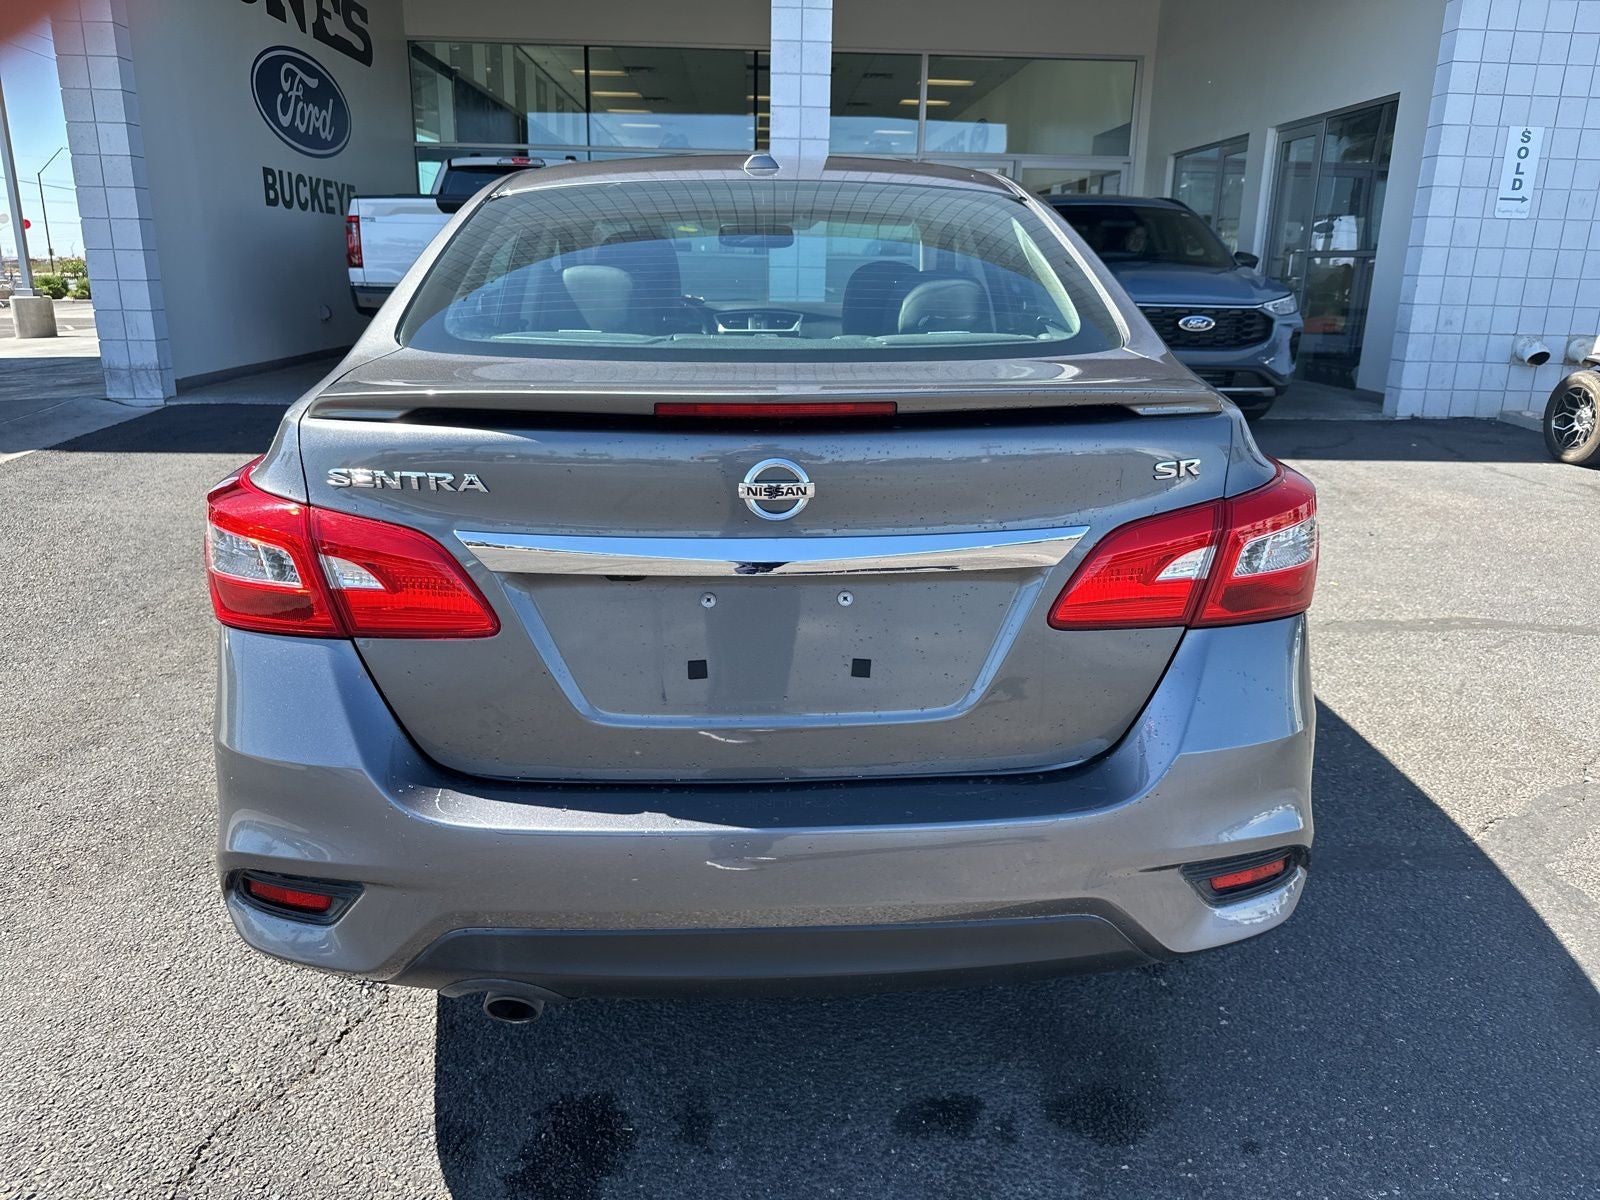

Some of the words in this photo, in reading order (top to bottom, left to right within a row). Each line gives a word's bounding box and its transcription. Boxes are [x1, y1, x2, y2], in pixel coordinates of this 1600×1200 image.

[277, 62, 335, 141] Ford
[1510, 129, 1532, 191] SOLD
[326, 468, 490, 493] SENTRA
[1153, 458, 1201, 480] SR
[746, 486, 807, 497] NISSAN
